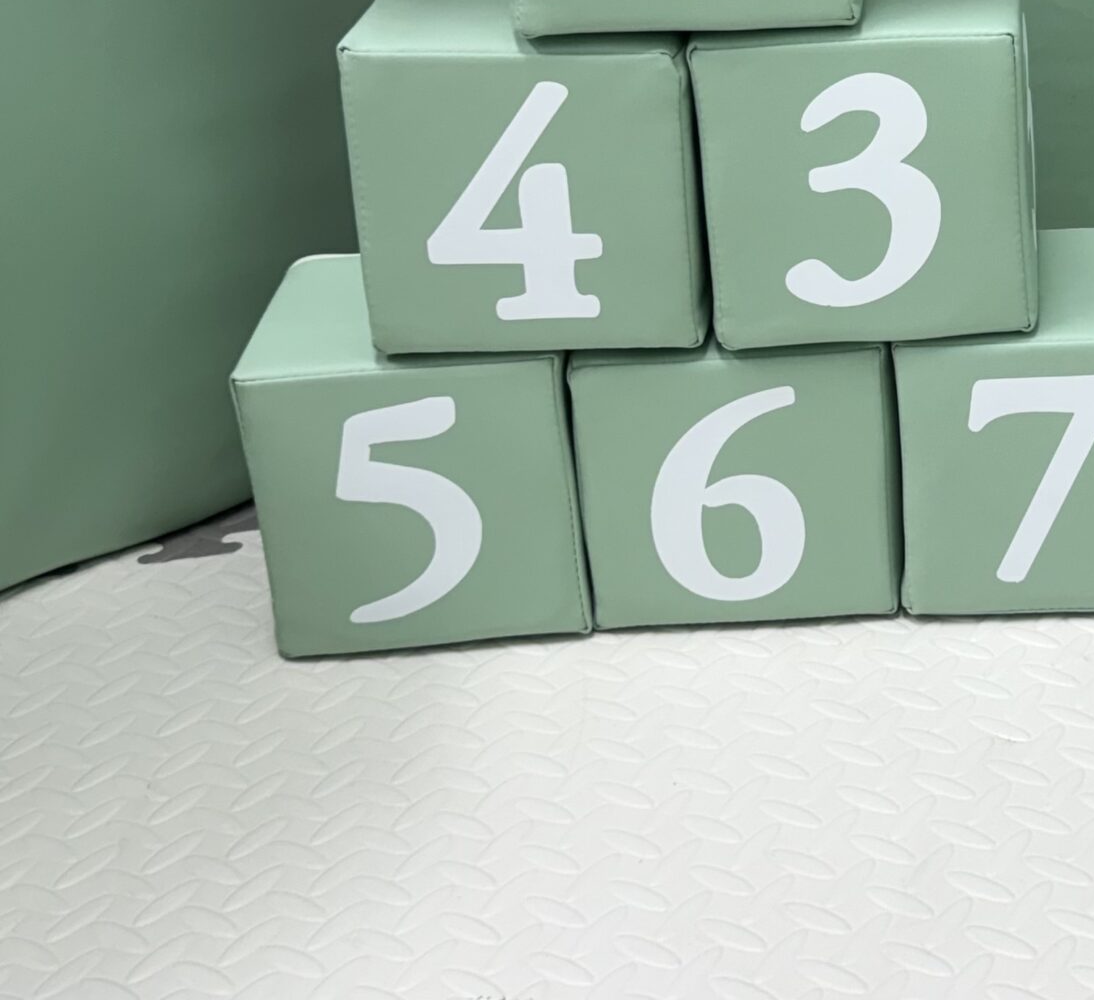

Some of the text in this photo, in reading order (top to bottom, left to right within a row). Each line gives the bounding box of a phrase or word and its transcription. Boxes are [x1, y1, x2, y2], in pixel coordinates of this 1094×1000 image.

[426, 81, 602, 320] 4
[785, 72, 942, 307] 3
[336, 396, 482, 623] 5
[651, 386, 806, 602] 6
